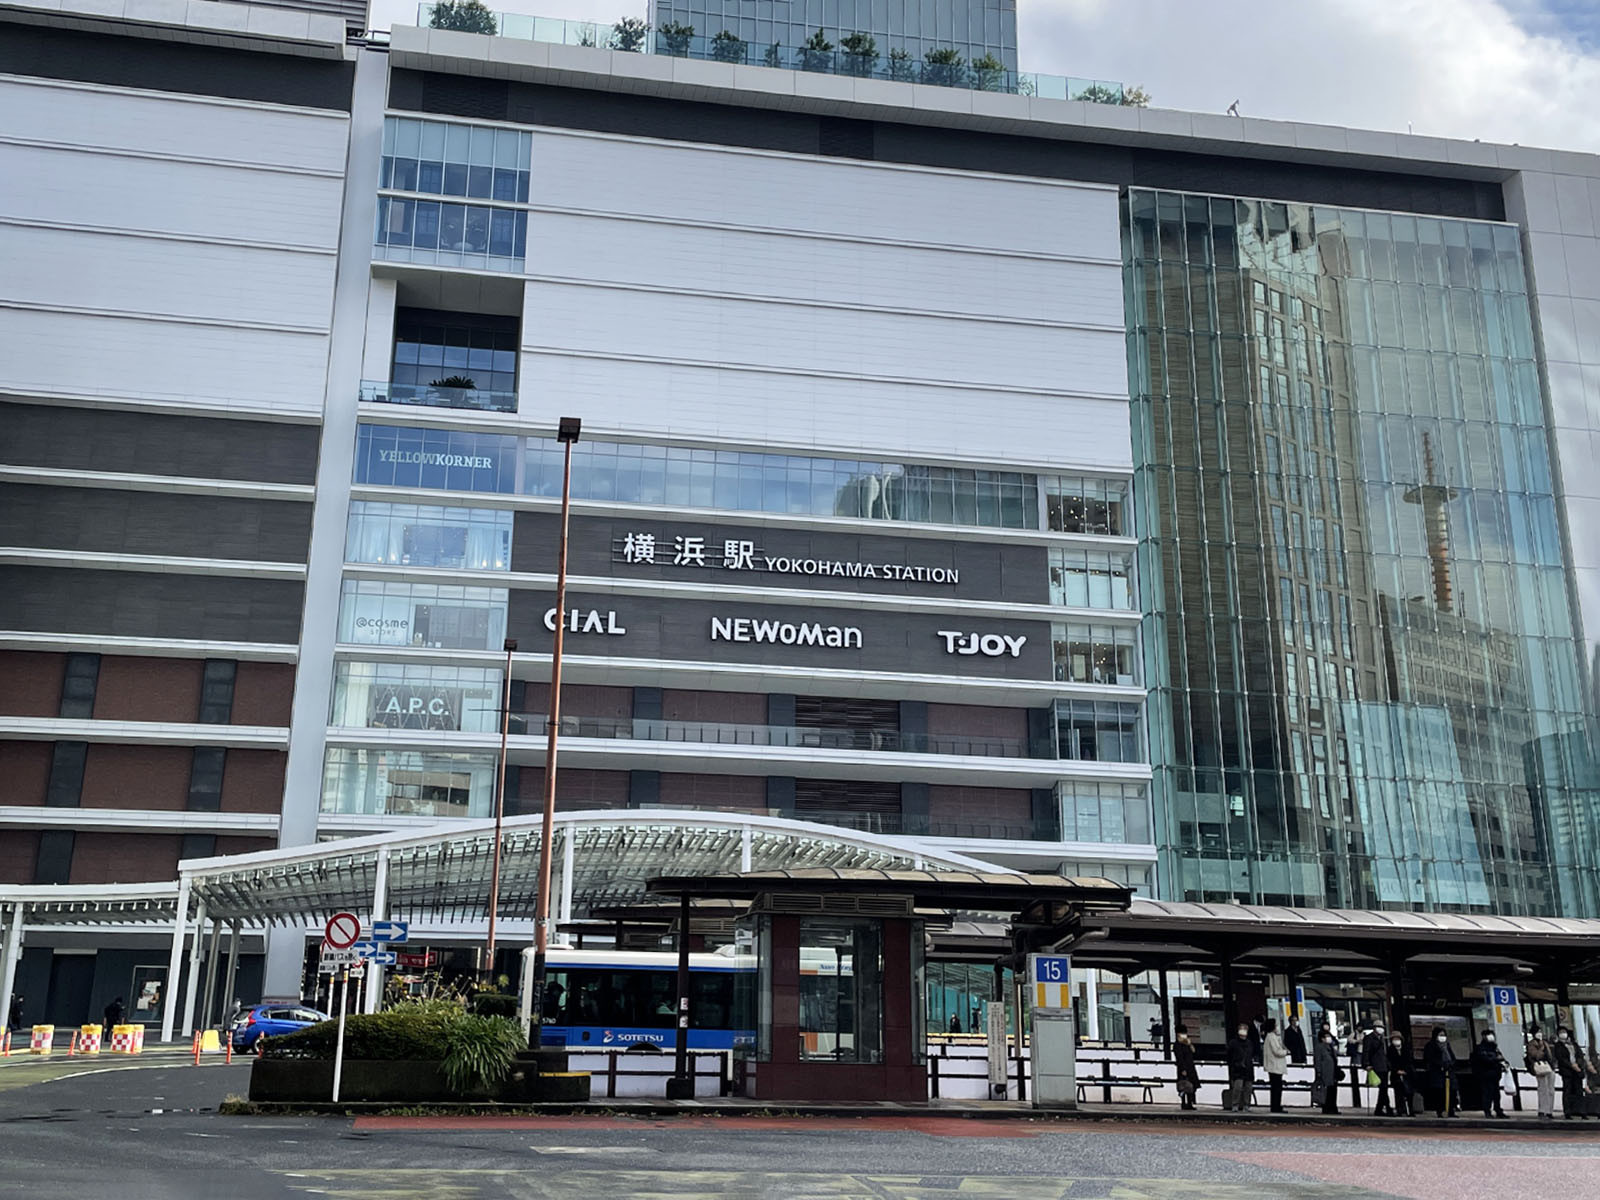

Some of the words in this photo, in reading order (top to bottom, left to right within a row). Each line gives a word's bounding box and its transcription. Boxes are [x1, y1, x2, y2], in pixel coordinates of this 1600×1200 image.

[623, 532, 754, 570] 横浜駅
[764, 556, 877, 578] YOKOHAMA
[882, 564, 959, 584] STATION
[355, 616, 409, 629] @cosme
[543, 607, 626, 634] CIAL
[711, 616, 863, 648] NEWoMan
[385, 696, 449, 716] A.P.C.
[1043, 960, 1061, 980] 15
[1499, 989, 1510, 1004] 9
[617, 1033, 664, 1042] SOTETSU
